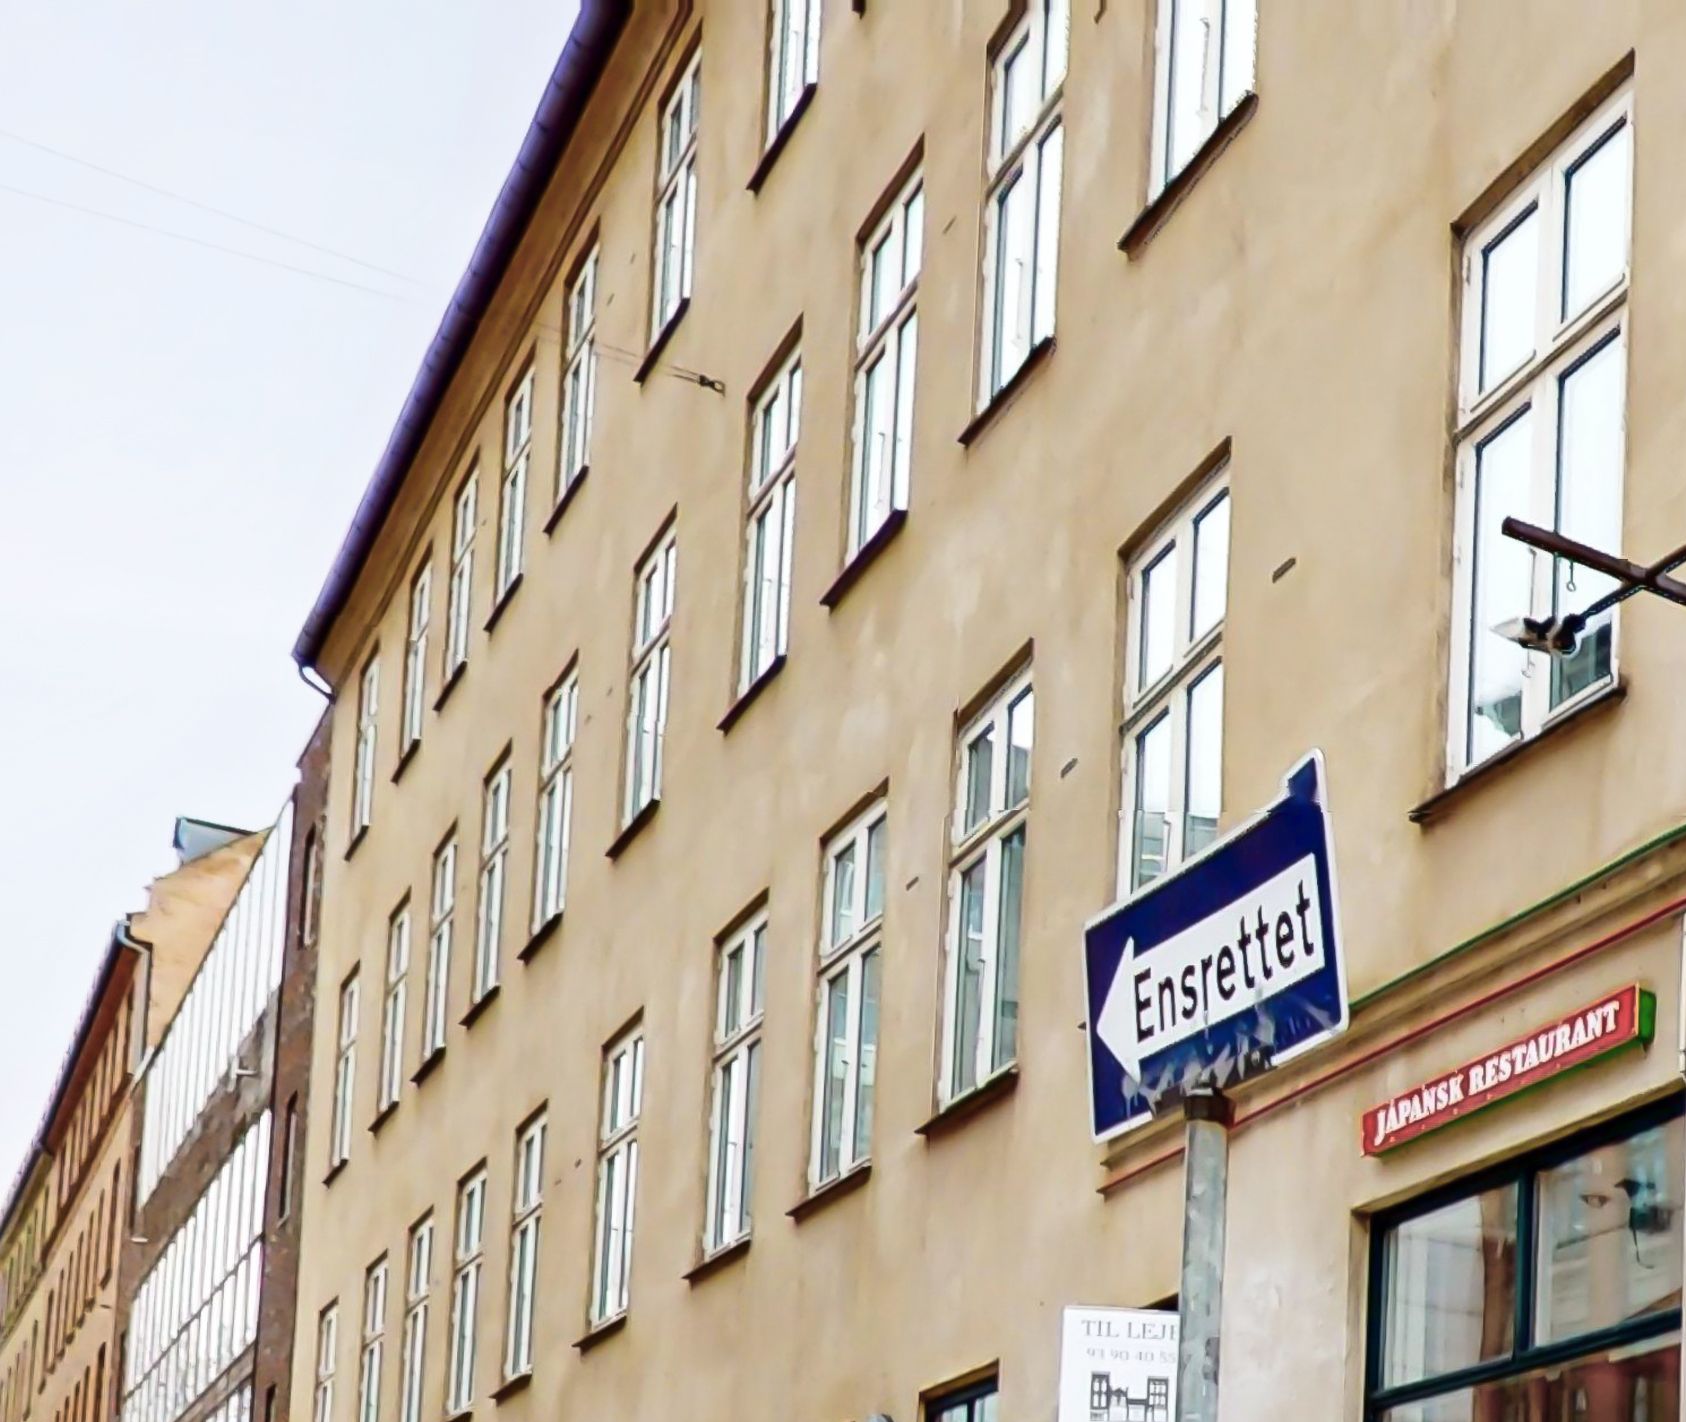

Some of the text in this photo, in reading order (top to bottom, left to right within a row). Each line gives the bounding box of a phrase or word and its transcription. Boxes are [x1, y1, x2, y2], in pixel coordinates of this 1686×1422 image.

[1133, 880, 1314, 1043] Ensrettet
[1374, 1000, 1620, 1146] JAPANSK RESTAURANT
